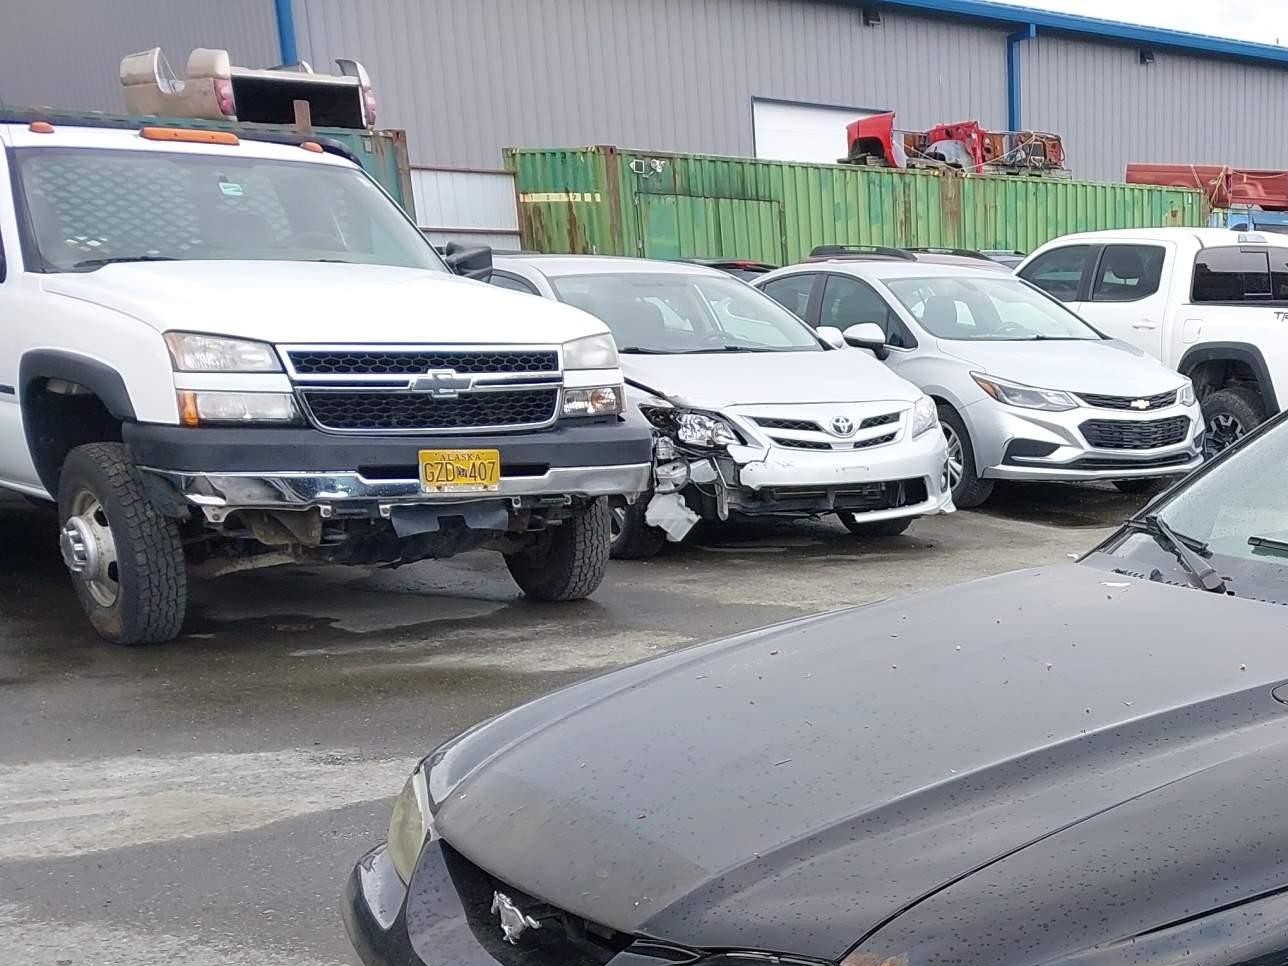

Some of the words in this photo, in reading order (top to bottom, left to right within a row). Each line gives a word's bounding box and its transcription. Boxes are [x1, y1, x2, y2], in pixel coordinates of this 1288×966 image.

[440, 453, 481, 462] ALASKA
[424, 462, 455, 483] GZD
[469, 461, 496, 482] 407
